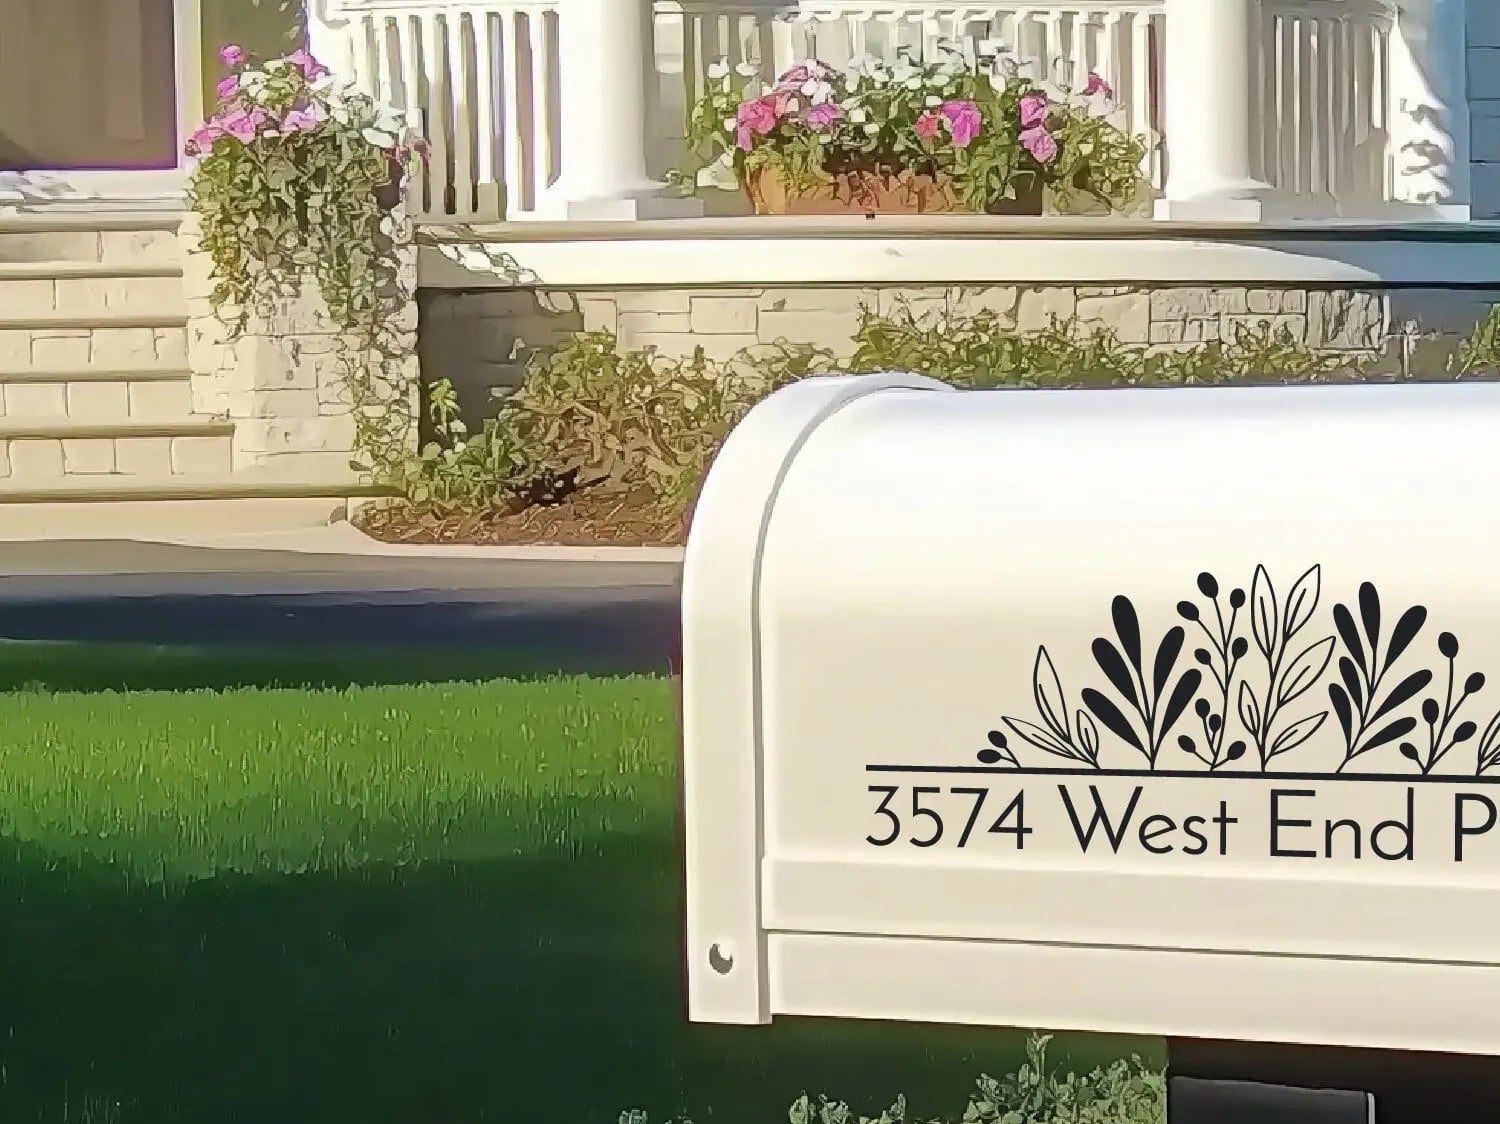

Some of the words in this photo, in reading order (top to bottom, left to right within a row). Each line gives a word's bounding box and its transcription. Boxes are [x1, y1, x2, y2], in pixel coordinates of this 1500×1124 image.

[865, 785, 1033, 850] 3574
[1057, 784, 1238, 856] West
[1270, 786, 1414, 861] End
